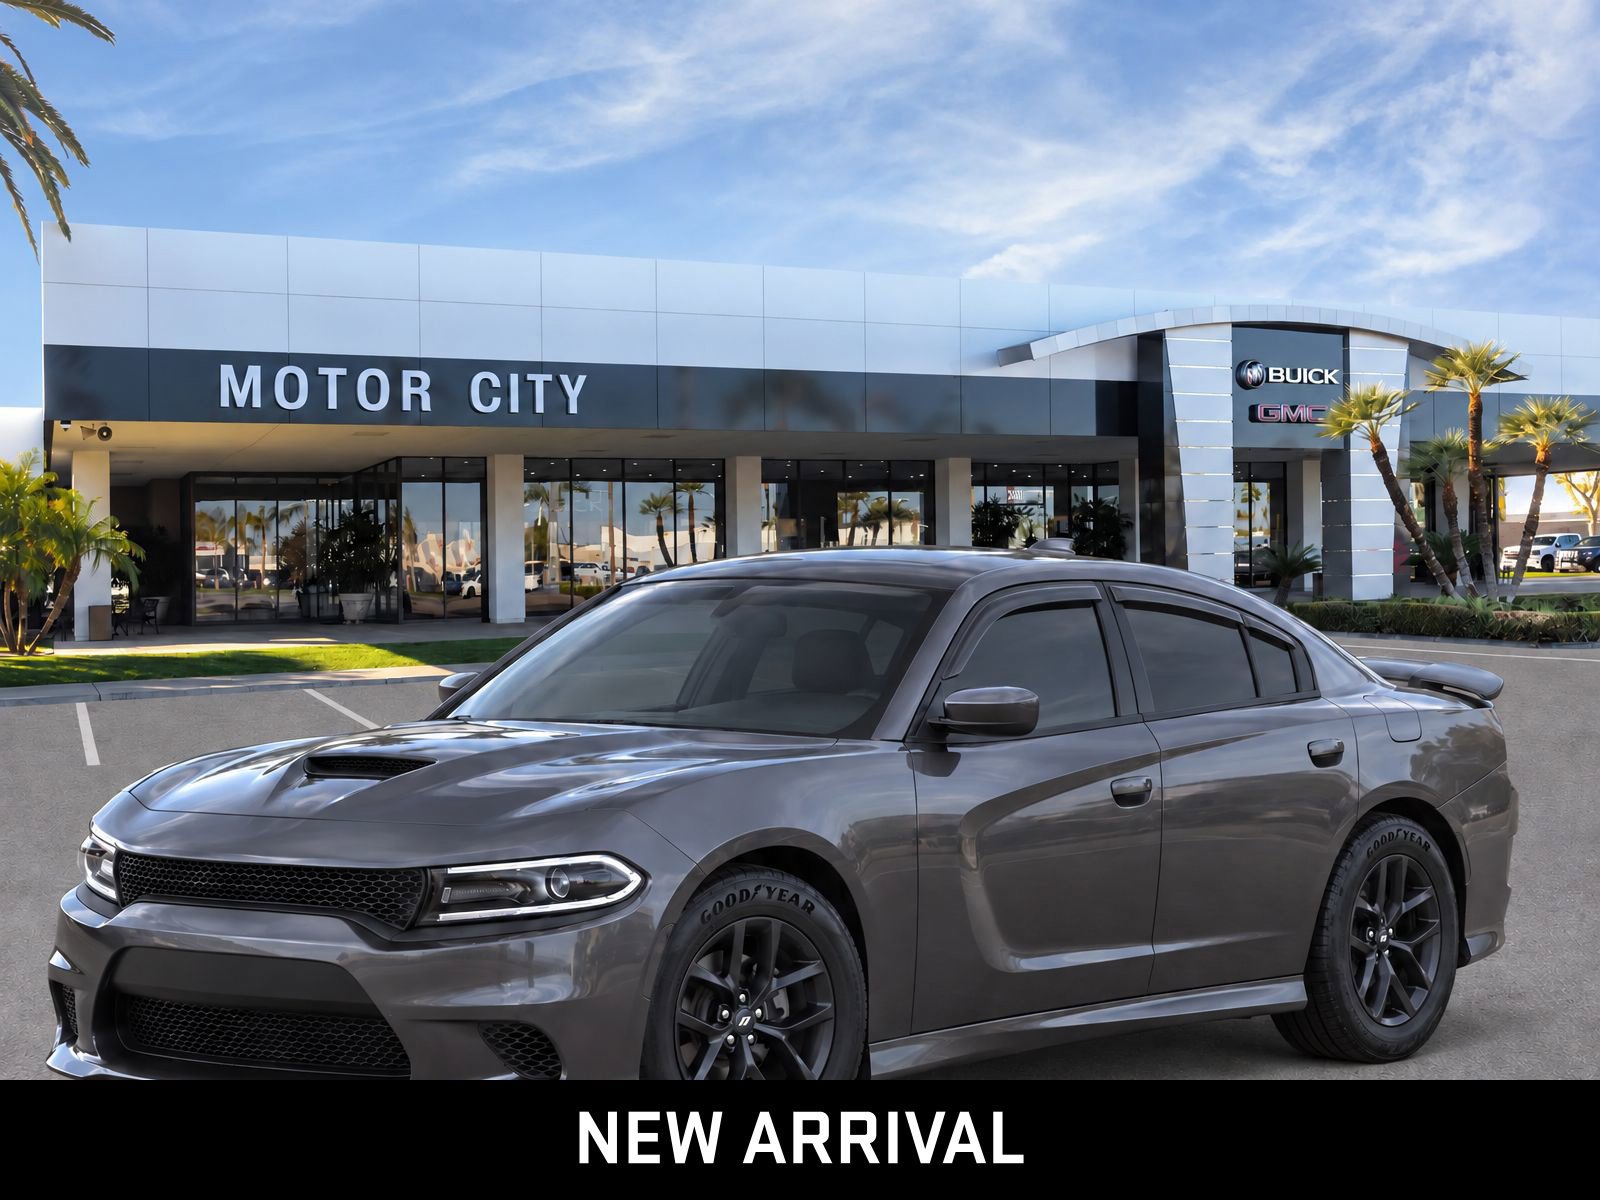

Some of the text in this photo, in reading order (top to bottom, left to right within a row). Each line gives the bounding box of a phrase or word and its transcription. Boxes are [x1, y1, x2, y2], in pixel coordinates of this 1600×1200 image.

[219, 363, 588, 415] MOTOR CITY
[1267, 366, 1340, 385] BUICK
[1257, 403, 1329, 423] GMC
[1366, 829, 1431, 859] GOODYEAR
[700, 884, 816, 924] GOODYEAR
